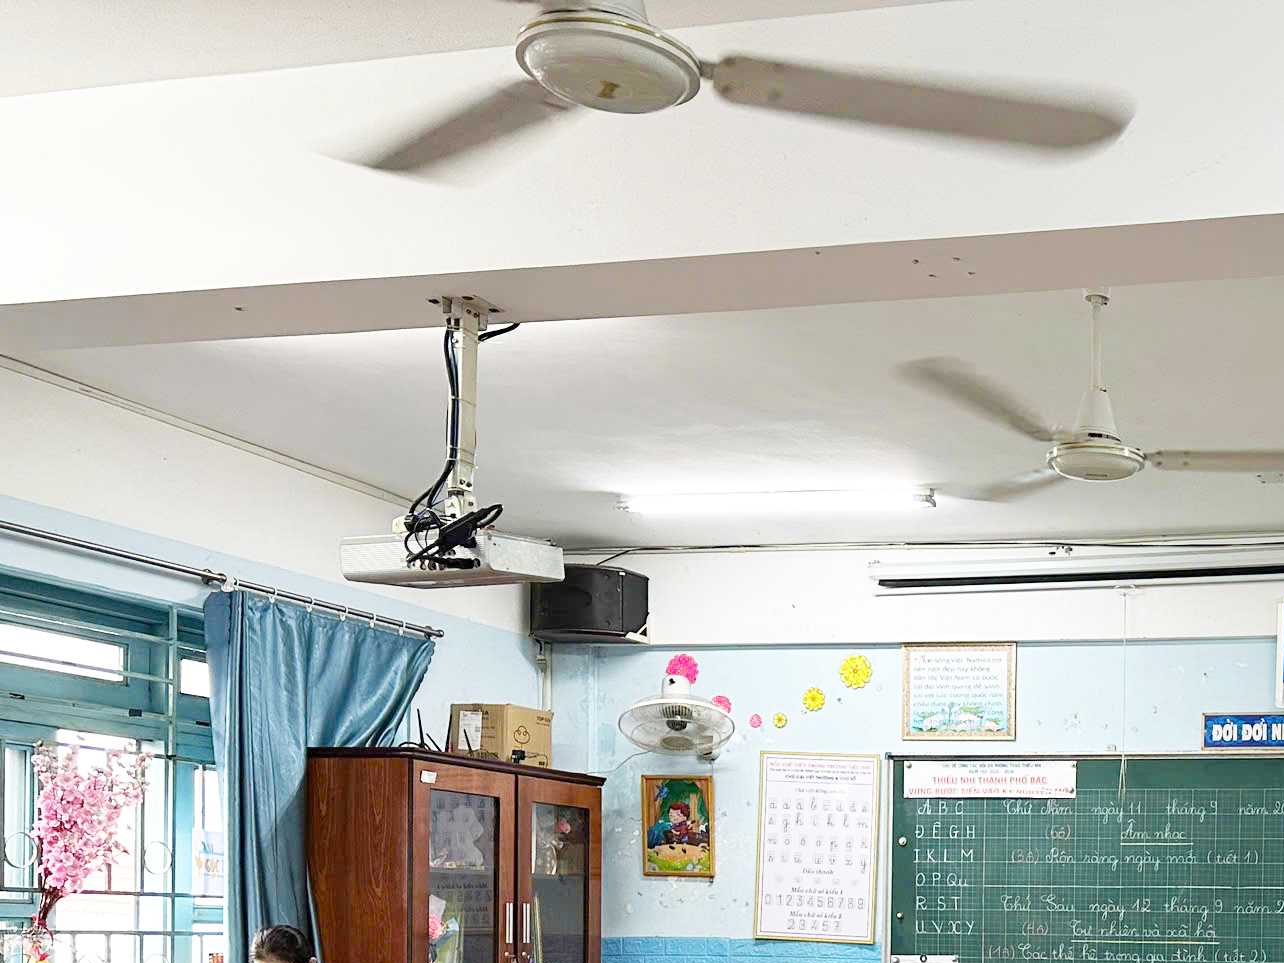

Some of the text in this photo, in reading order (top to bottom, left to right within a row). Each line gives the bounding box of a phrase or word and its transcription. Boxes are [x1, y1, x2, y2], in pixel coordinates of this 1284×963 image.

[1212, 718, 1238, 741] ĐỜI
[1128, 802, 1141, 815] 11
[1167, 799, 1206, 823] tháng
[1210, 801, 1218, 815] 9
[1131, 898, 1151, 913] 12
[1164, 896, 1209, 922] tháng
[1215, 900, 1223, 913] 9
